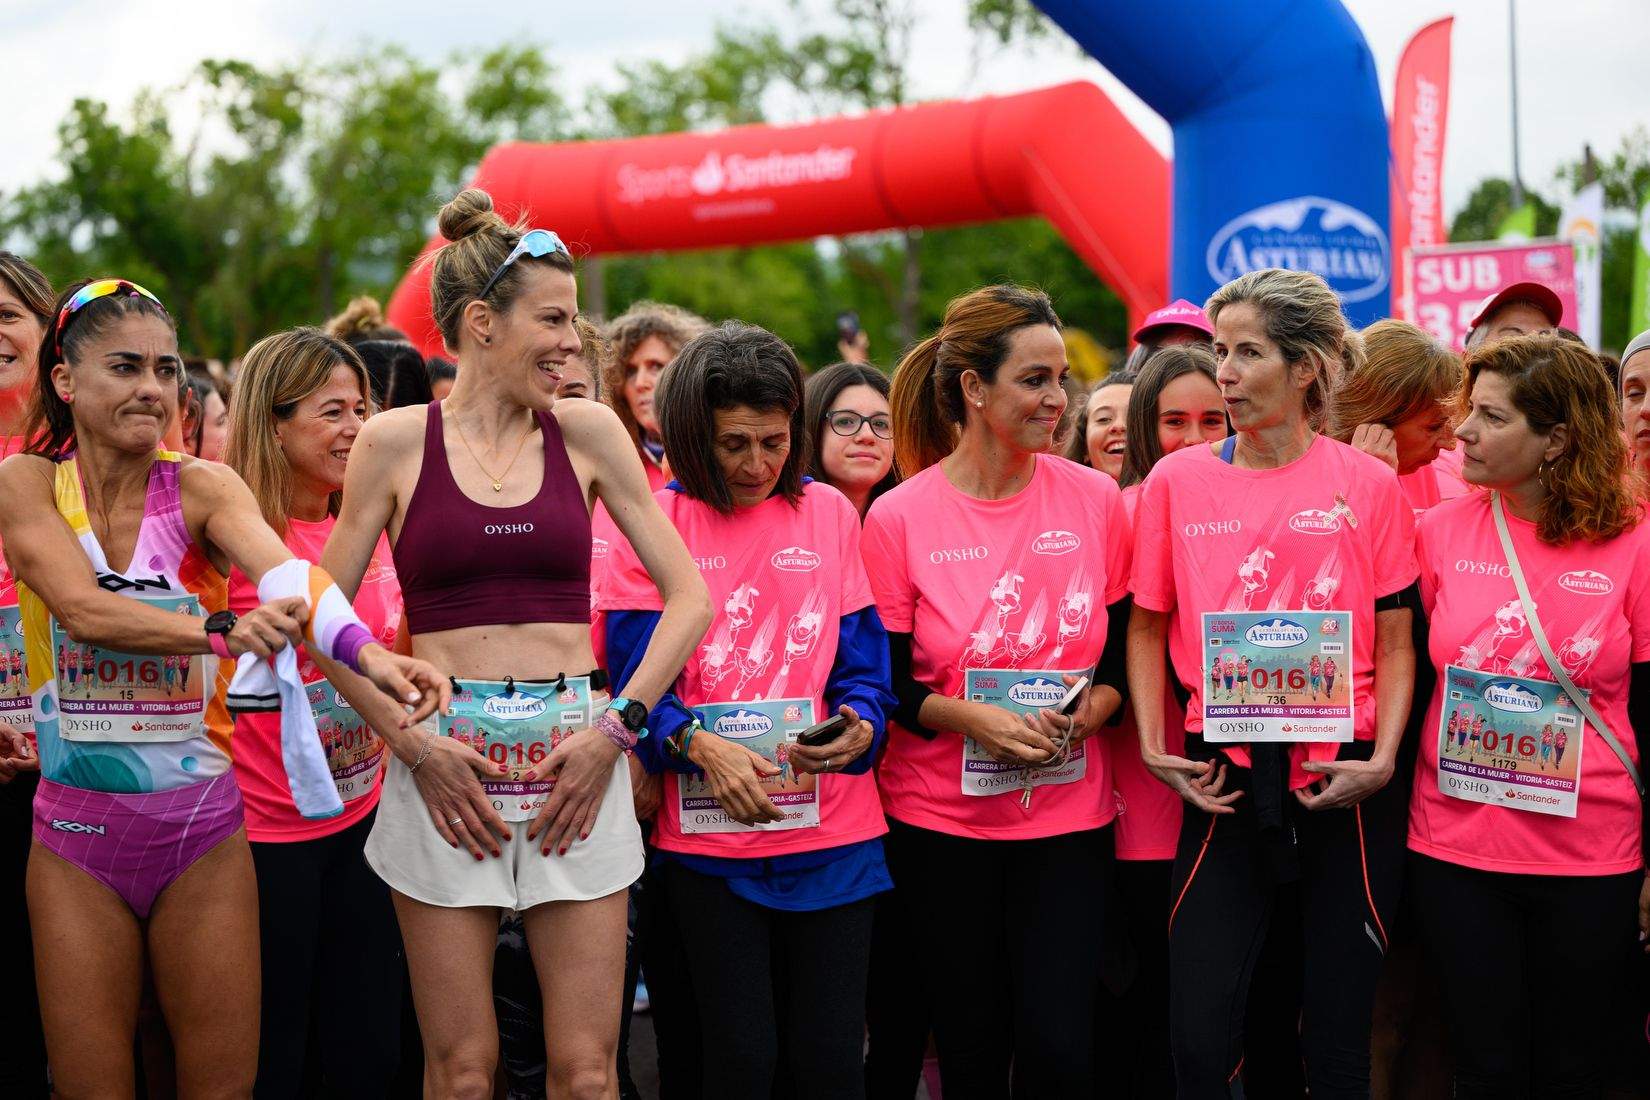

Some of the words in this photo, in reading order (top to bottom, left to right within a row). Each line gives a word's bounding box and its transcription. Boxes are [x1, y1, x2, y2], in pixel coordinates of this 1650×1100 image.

[1409, 73, 1438, 248] antander
[726, 146, 857, 192] Santander
[1416, 255, 1499, 296] SUB
[484, 522, 534, 535] OYSHO
[1185, 519, 1242, 537] OYSHO
[1036, 539, 1078, 551] ASTURIANA
[775, 555, 818, 567] ASTURIANA
[930, 546, 988, 564] OYSHO
[692, 556, 727, 570] SHO
[1455, 559, 1512, 578] OYSHO
[1563, 575, 1610, 592] ASTURIANA
[1211, 625, 1236, 633] SUMA
[1250, 629, 1305, 642] ASTURIANA
[98, 660, 161, 684] 016
[974, 681, 998, 689] SUMA
[1251, 668, 1306, 690] 016
[119, 690, 134, 701] 15
[1011, 687, 1065, 700] ASTURIANA
[1267, 695, 1286, 705] 736
[1487, 690, 1540, 710] ASTURIANA
[86, 701, 96, 711] DE
[97, 701, 107, 711] LA
[109, 702, 134, 712] MUJER
[487, 702, 543, 714] ASTURIANA
[145, 721, 192, 732] Santander
[717, 720, 770, 733] ASTURIANA
[1219, 722, 1265, 733] OYSHO
[1293, 723, 1338, 733] Santander
[1482, 730, 1537, 757] 016
[353, 750, 366, 762] 737
[488, 741, 546, 765] 016
[968, 762, 999, 771] CARRERA
[1491, 757, 1517, 771] 1179
[513, 771, 520, 781] 2
[978, 774, 1018, 788] OYSHO
[1442, 760, 1467, 773] CARRERA
[1468, 766, 1476, 774] DE
[1487, 769, 1510, 780] MUJER
[1515, 774, 1573, 789] VITORIA-GASTEIZ
[489, 784, 497, 792] LA
[500, 784, 524, 792] MUJER
[1448, 777, 1489, 794] OYSHO
[1516, 791, 1561, 806] Santander
[685, 800, 713, 808] CARRERA
